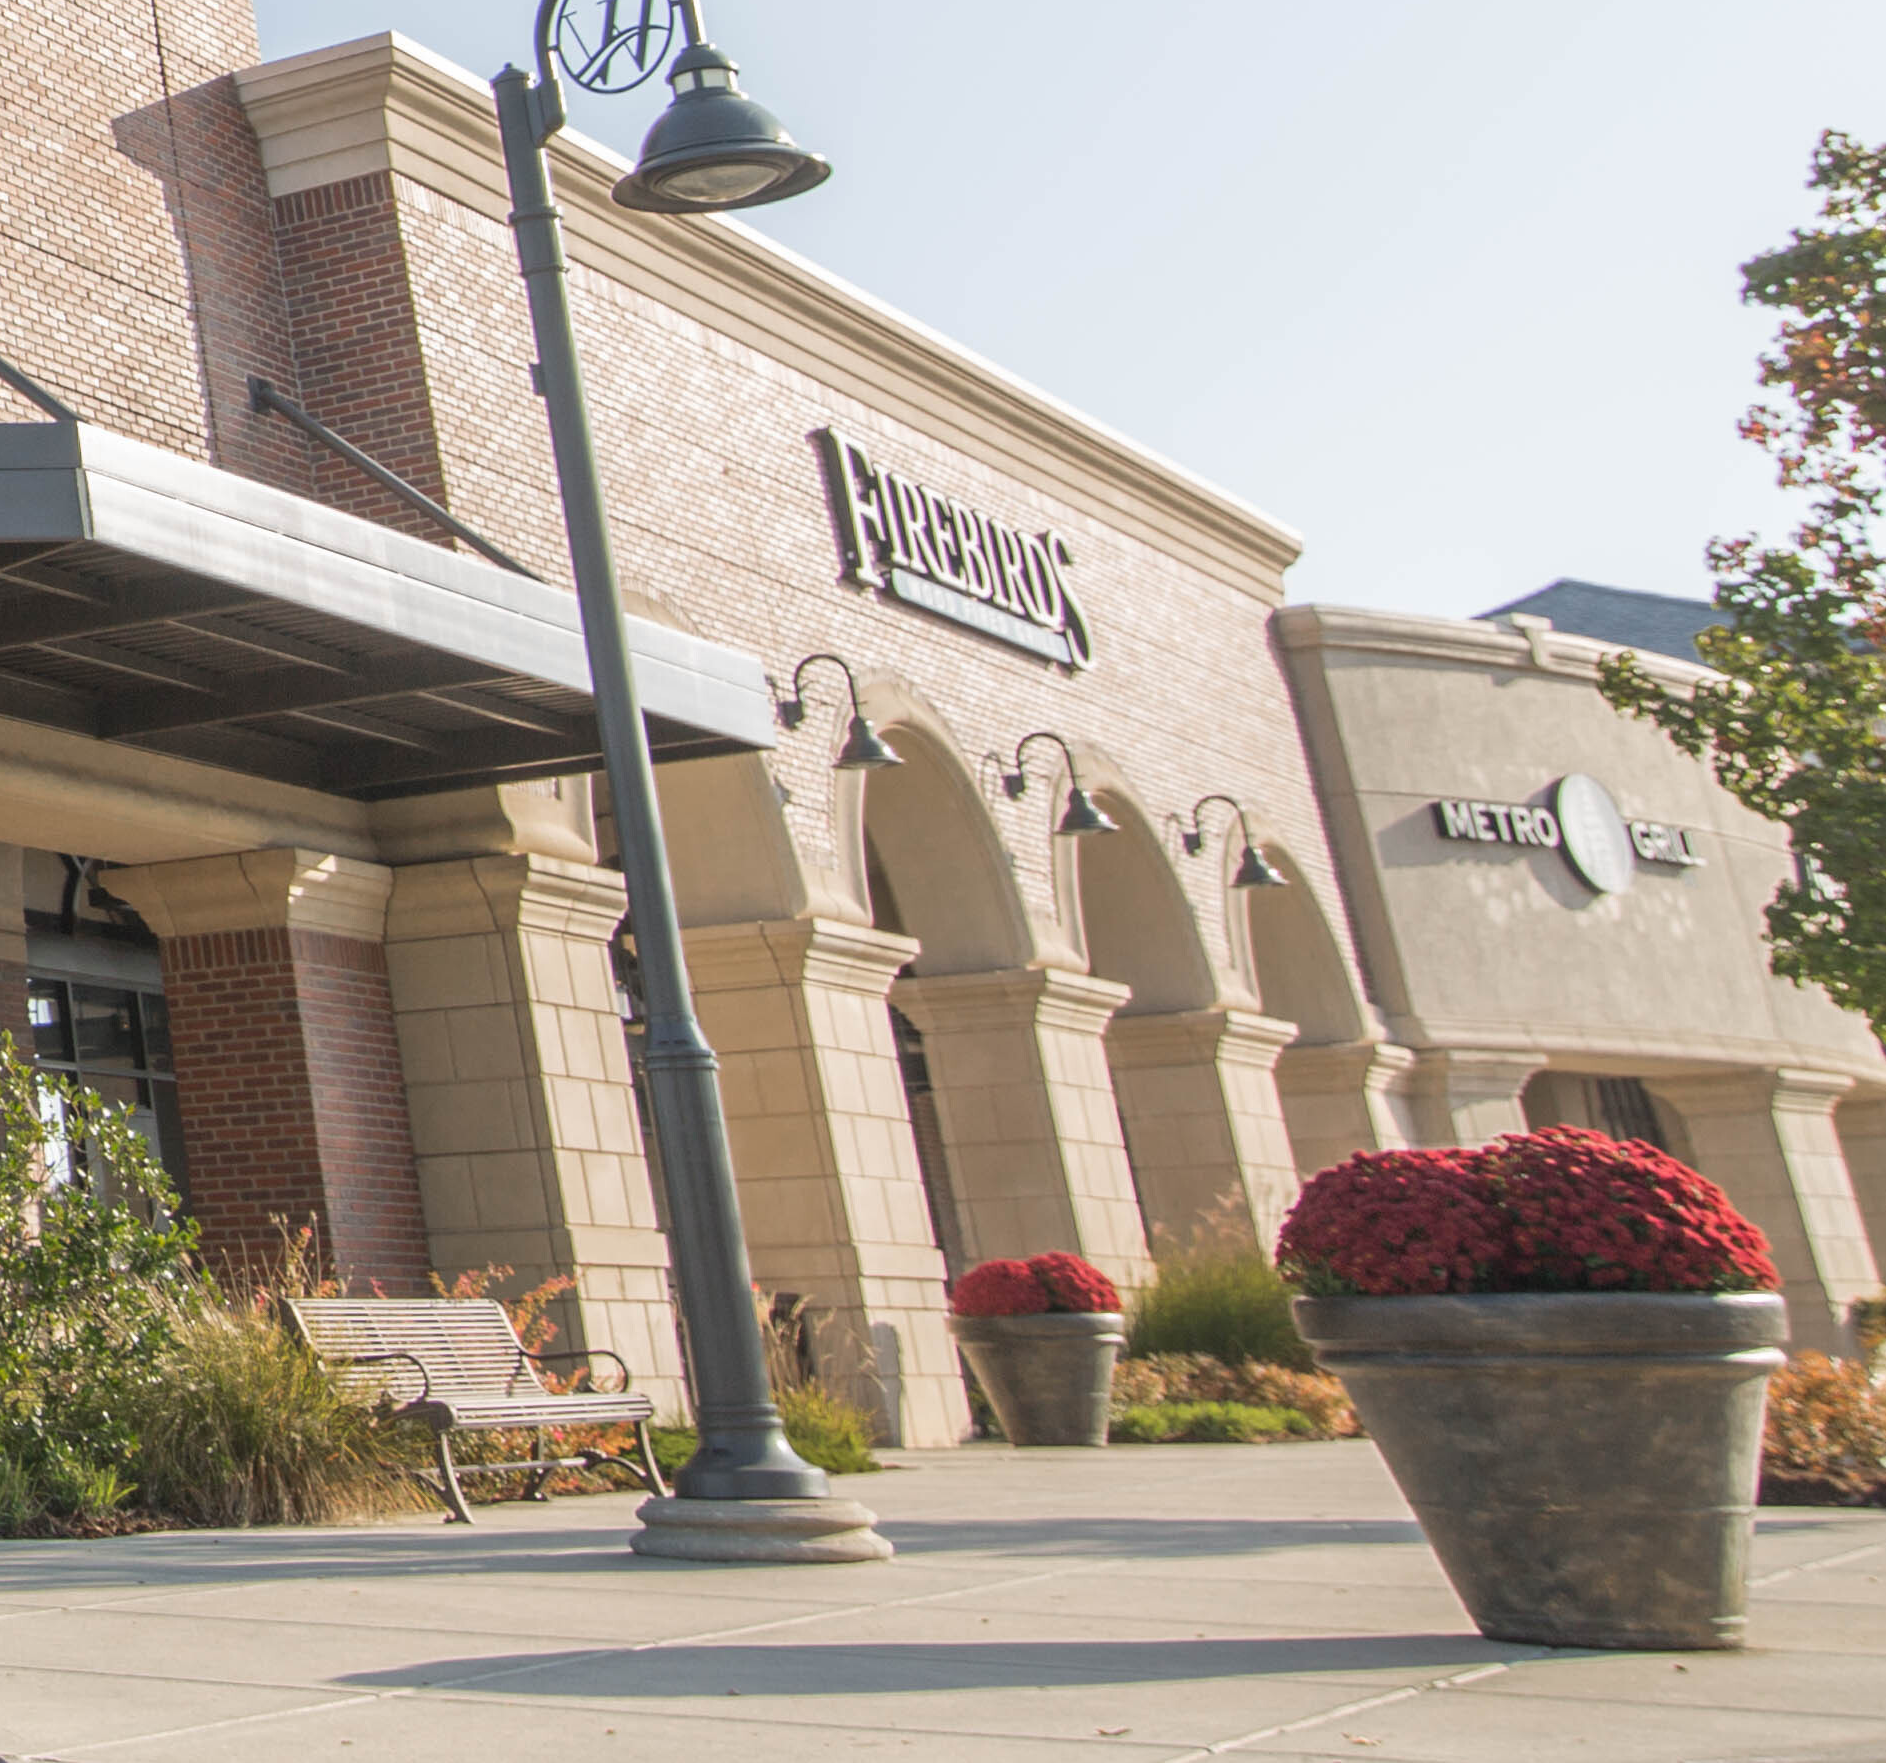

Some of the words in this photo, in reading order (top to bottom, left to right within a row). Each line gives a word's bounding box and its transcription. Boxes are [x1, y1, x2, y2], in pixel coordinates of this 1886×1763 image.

[806, 425, 1095, 670] FIREBIRDS
[1435, 799, 1560, 848] METRO
[1629, 821, 1708, 867] GRILL
